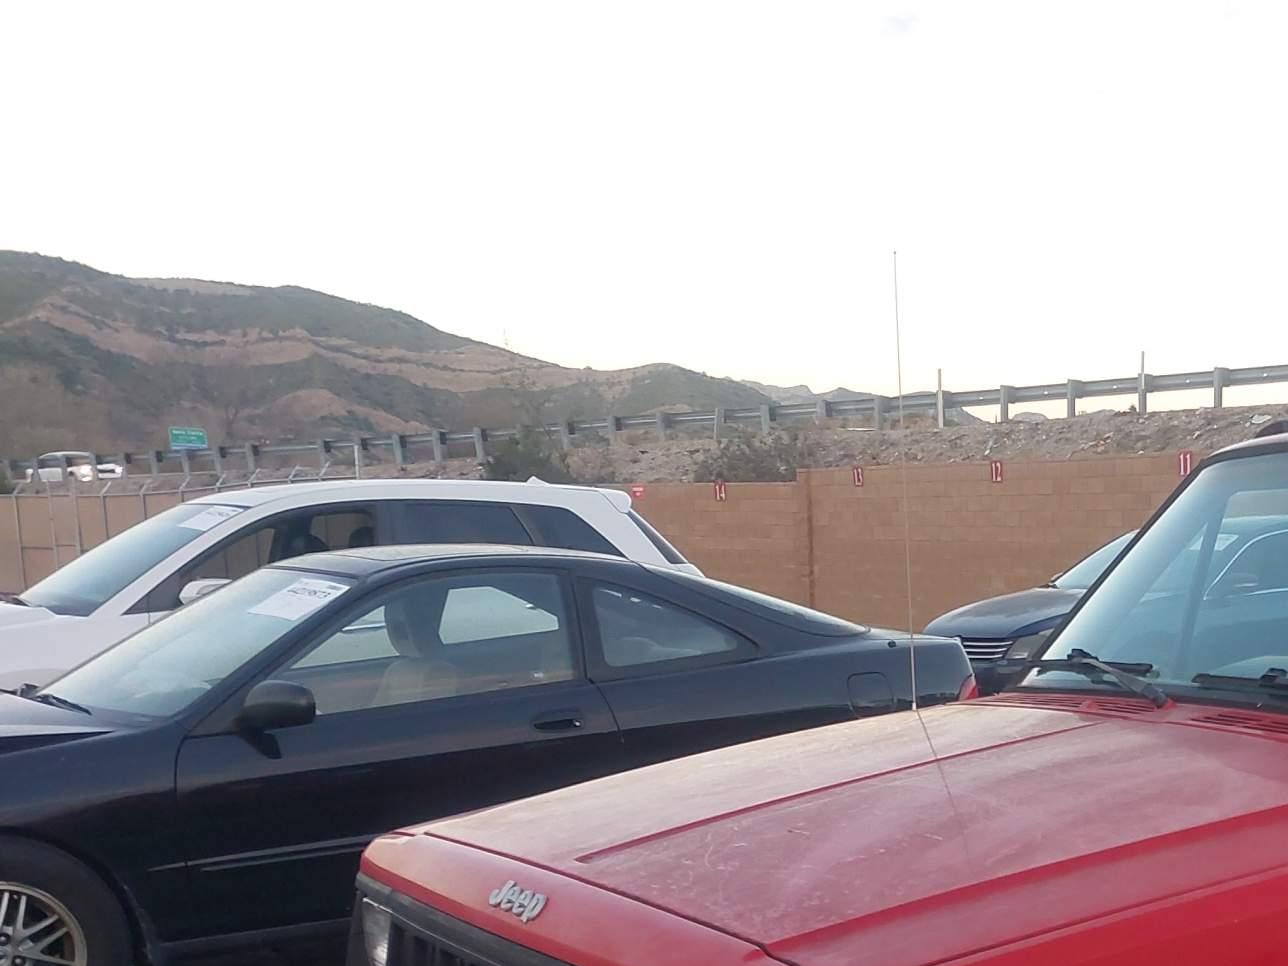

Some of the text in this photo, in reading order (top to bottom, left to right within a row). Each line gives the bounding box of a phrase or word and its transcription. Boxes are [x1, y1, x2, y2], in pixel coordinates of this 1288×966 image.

[992, 461, 1001, 481] 12
[1180, 453, 1190, 475] 11
[715, 484, 726, 501] 14
[488, 879, 548, 924] Jeep
